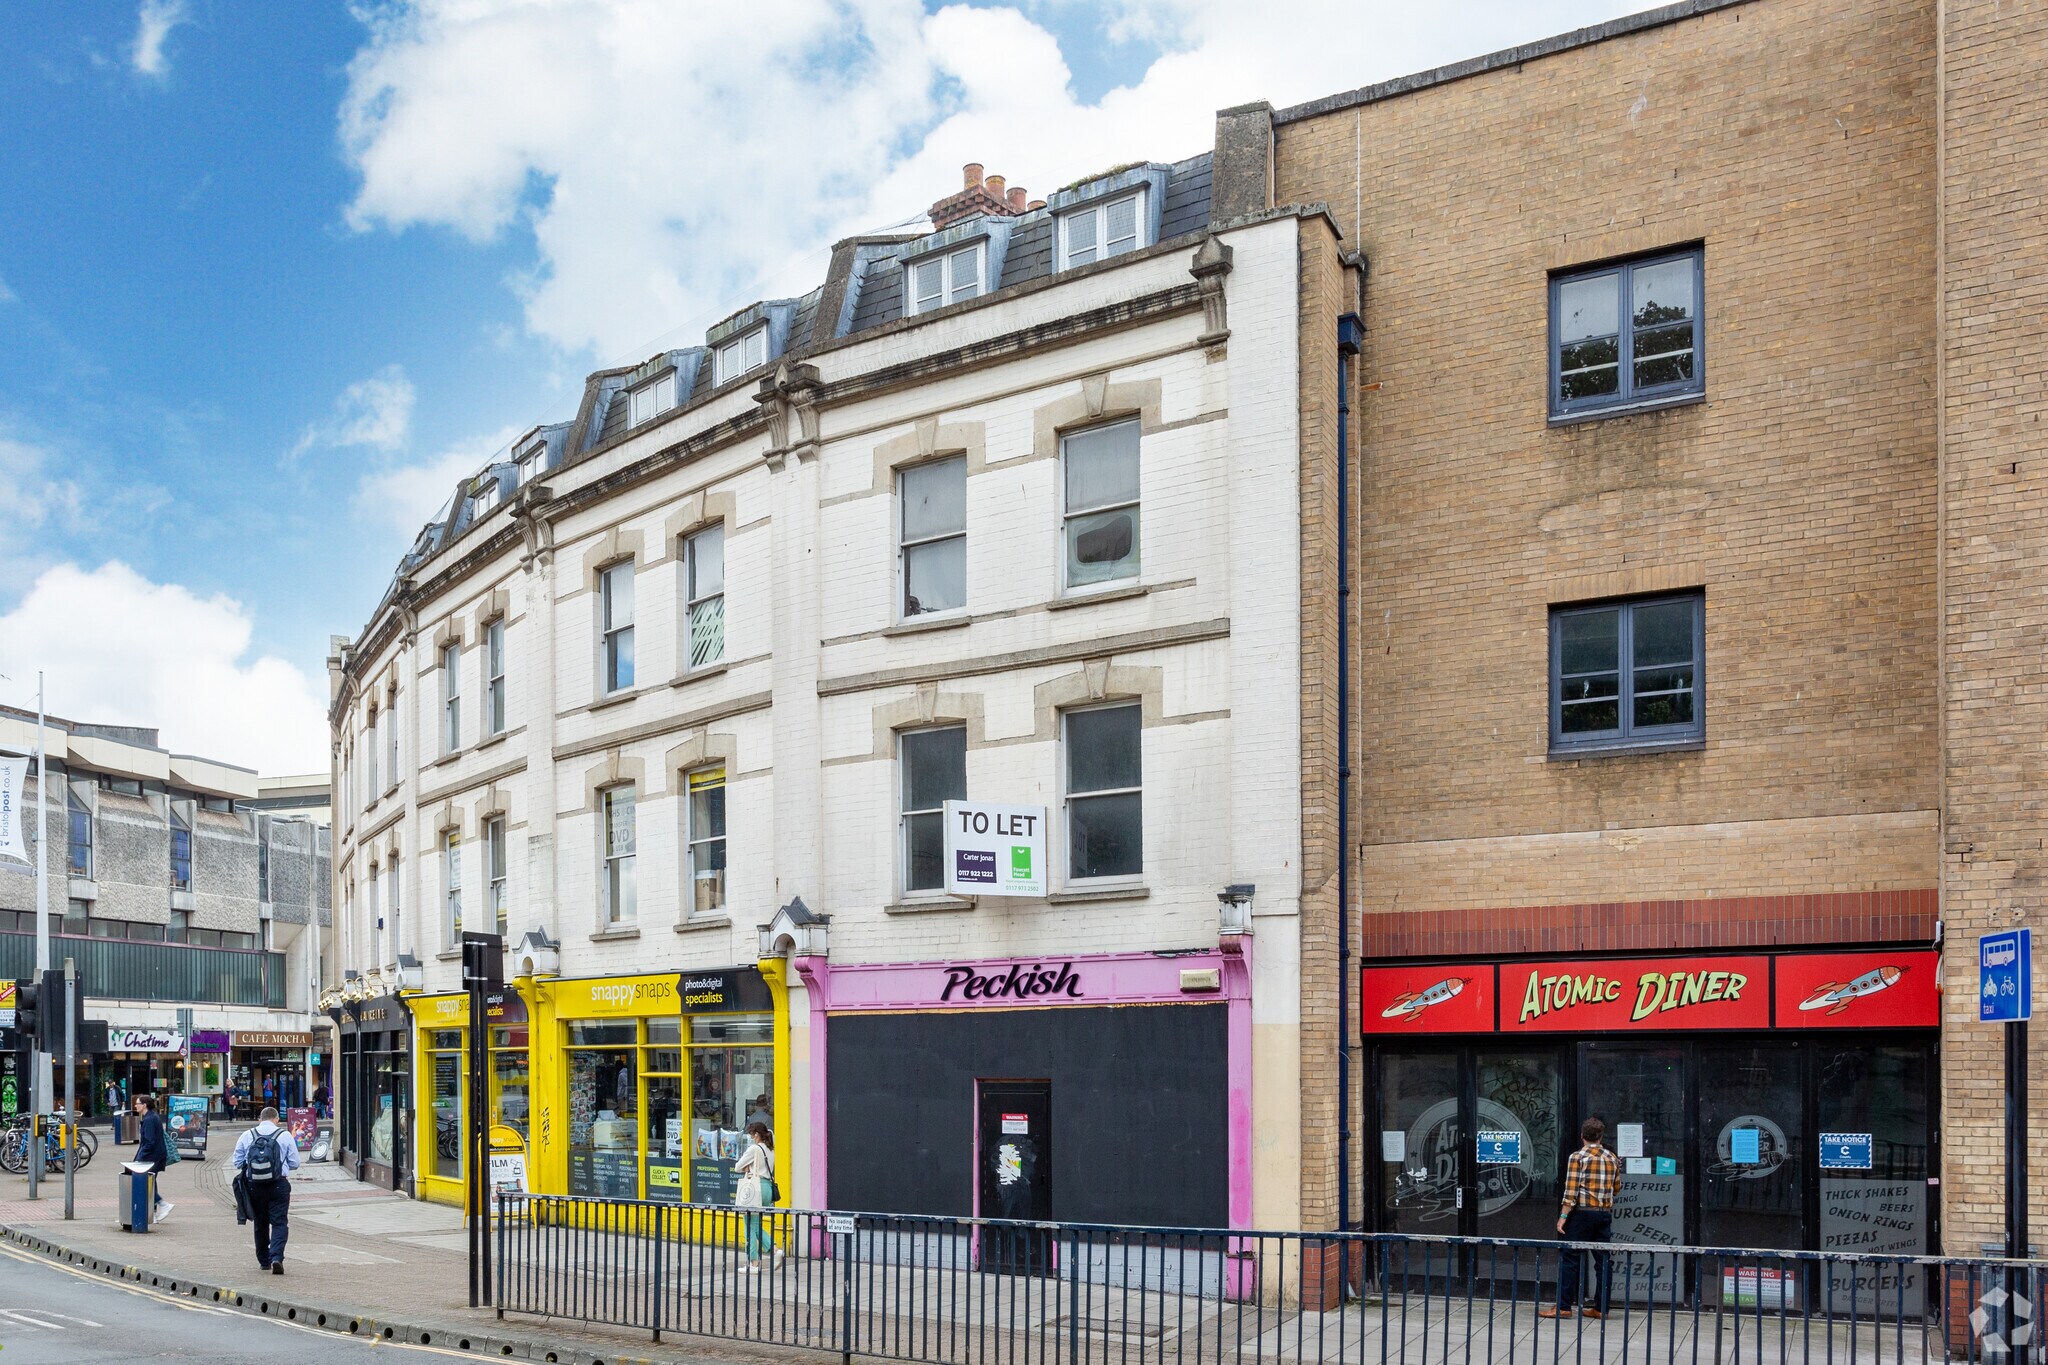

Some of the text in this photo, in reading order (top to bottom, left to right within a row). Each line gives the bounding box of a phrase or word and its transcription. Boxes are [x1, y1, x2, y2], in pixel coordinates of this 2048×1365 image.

[0, 765, 11, 837] bristolpost.co.uk
[958, 811, 1037, 837] TO LET
[609, 829, 630, 844] DVD
[963, 853, 994, 862] Carter Jonas
[685, 977, 723, 991] photo&digital
[940, 962, 1084, 1001] Peckish
[591, 982, 671, 1006] snappysnaps
[685, 991, 723, 1007] specialists
[1630, 970, 1748, 1022] DINER
[1983, 1002, 1995, 1015] taxi
[124, 1031, 170, 1048] Chatime
[272, 1034, 306, 1044] MOCHA
[173, 1103, 202, 1111] CONFIDENCE
[667, 1131, 678, 1139] DVD
[491, 1159, 509, 1168] ILM
[1641, 1182, 1673, 1192] FRIES
[1825, 1186, 1910, 1200] THICK SHAKES
[1611, 1205, 1669, 1220] URGERS
[1879, 1203, 1914, 1213] BEERS
[1828, 1206, 1915, 1231] ONION RINGS
[1633, 1223, 1678, 1246] BEERS
[1825, 1230, 1878, 1248] PIZZAS
[1868, 1239, 1917, 1254] HOT WINGS
[1738, 1270, 1775, 1278] WARING
[1635, 1282, 1673, 1292] SHKES
